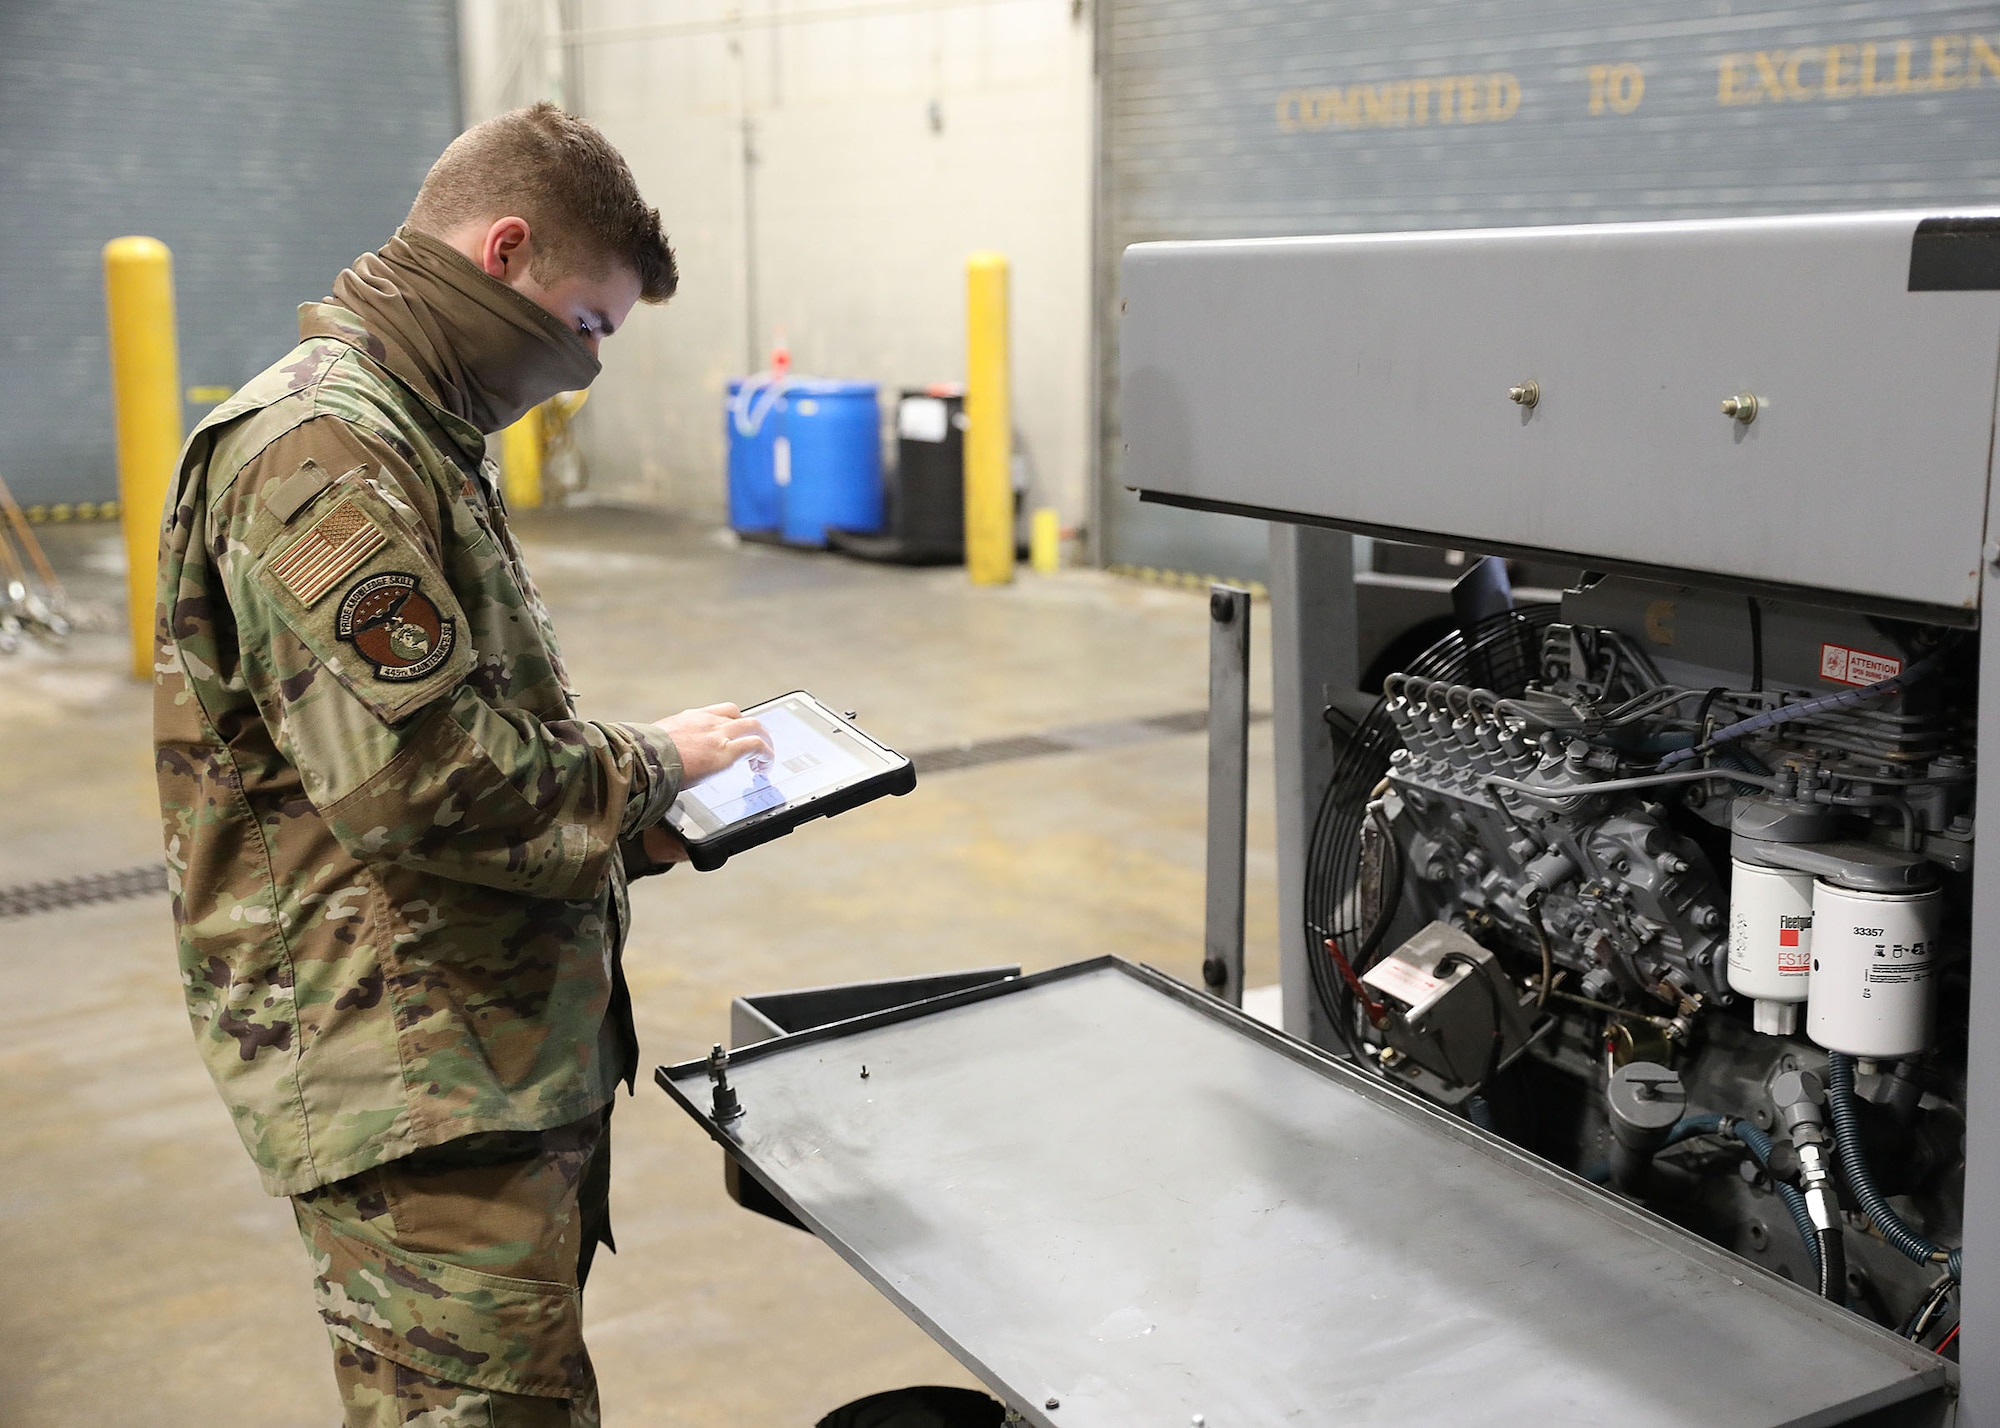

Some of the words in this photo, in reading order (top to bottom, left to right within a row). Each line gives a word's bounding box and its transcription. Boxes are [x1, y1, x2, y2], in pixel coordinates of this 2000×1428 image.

[1276, 72, 1521, 134] COMMITTED
[1586, 62, 1645, 115] TO
[389, 575, 413, 586] SKILL
[346, 578, 388, 608] KNOWLEDGE
[341, 609, 352, 633] PRIDE
[1851, 657, 1897, 675] ATTENTION
[1853, 926, 1884, 937] 33357
[1778, 952, 1811, 966] FS12
